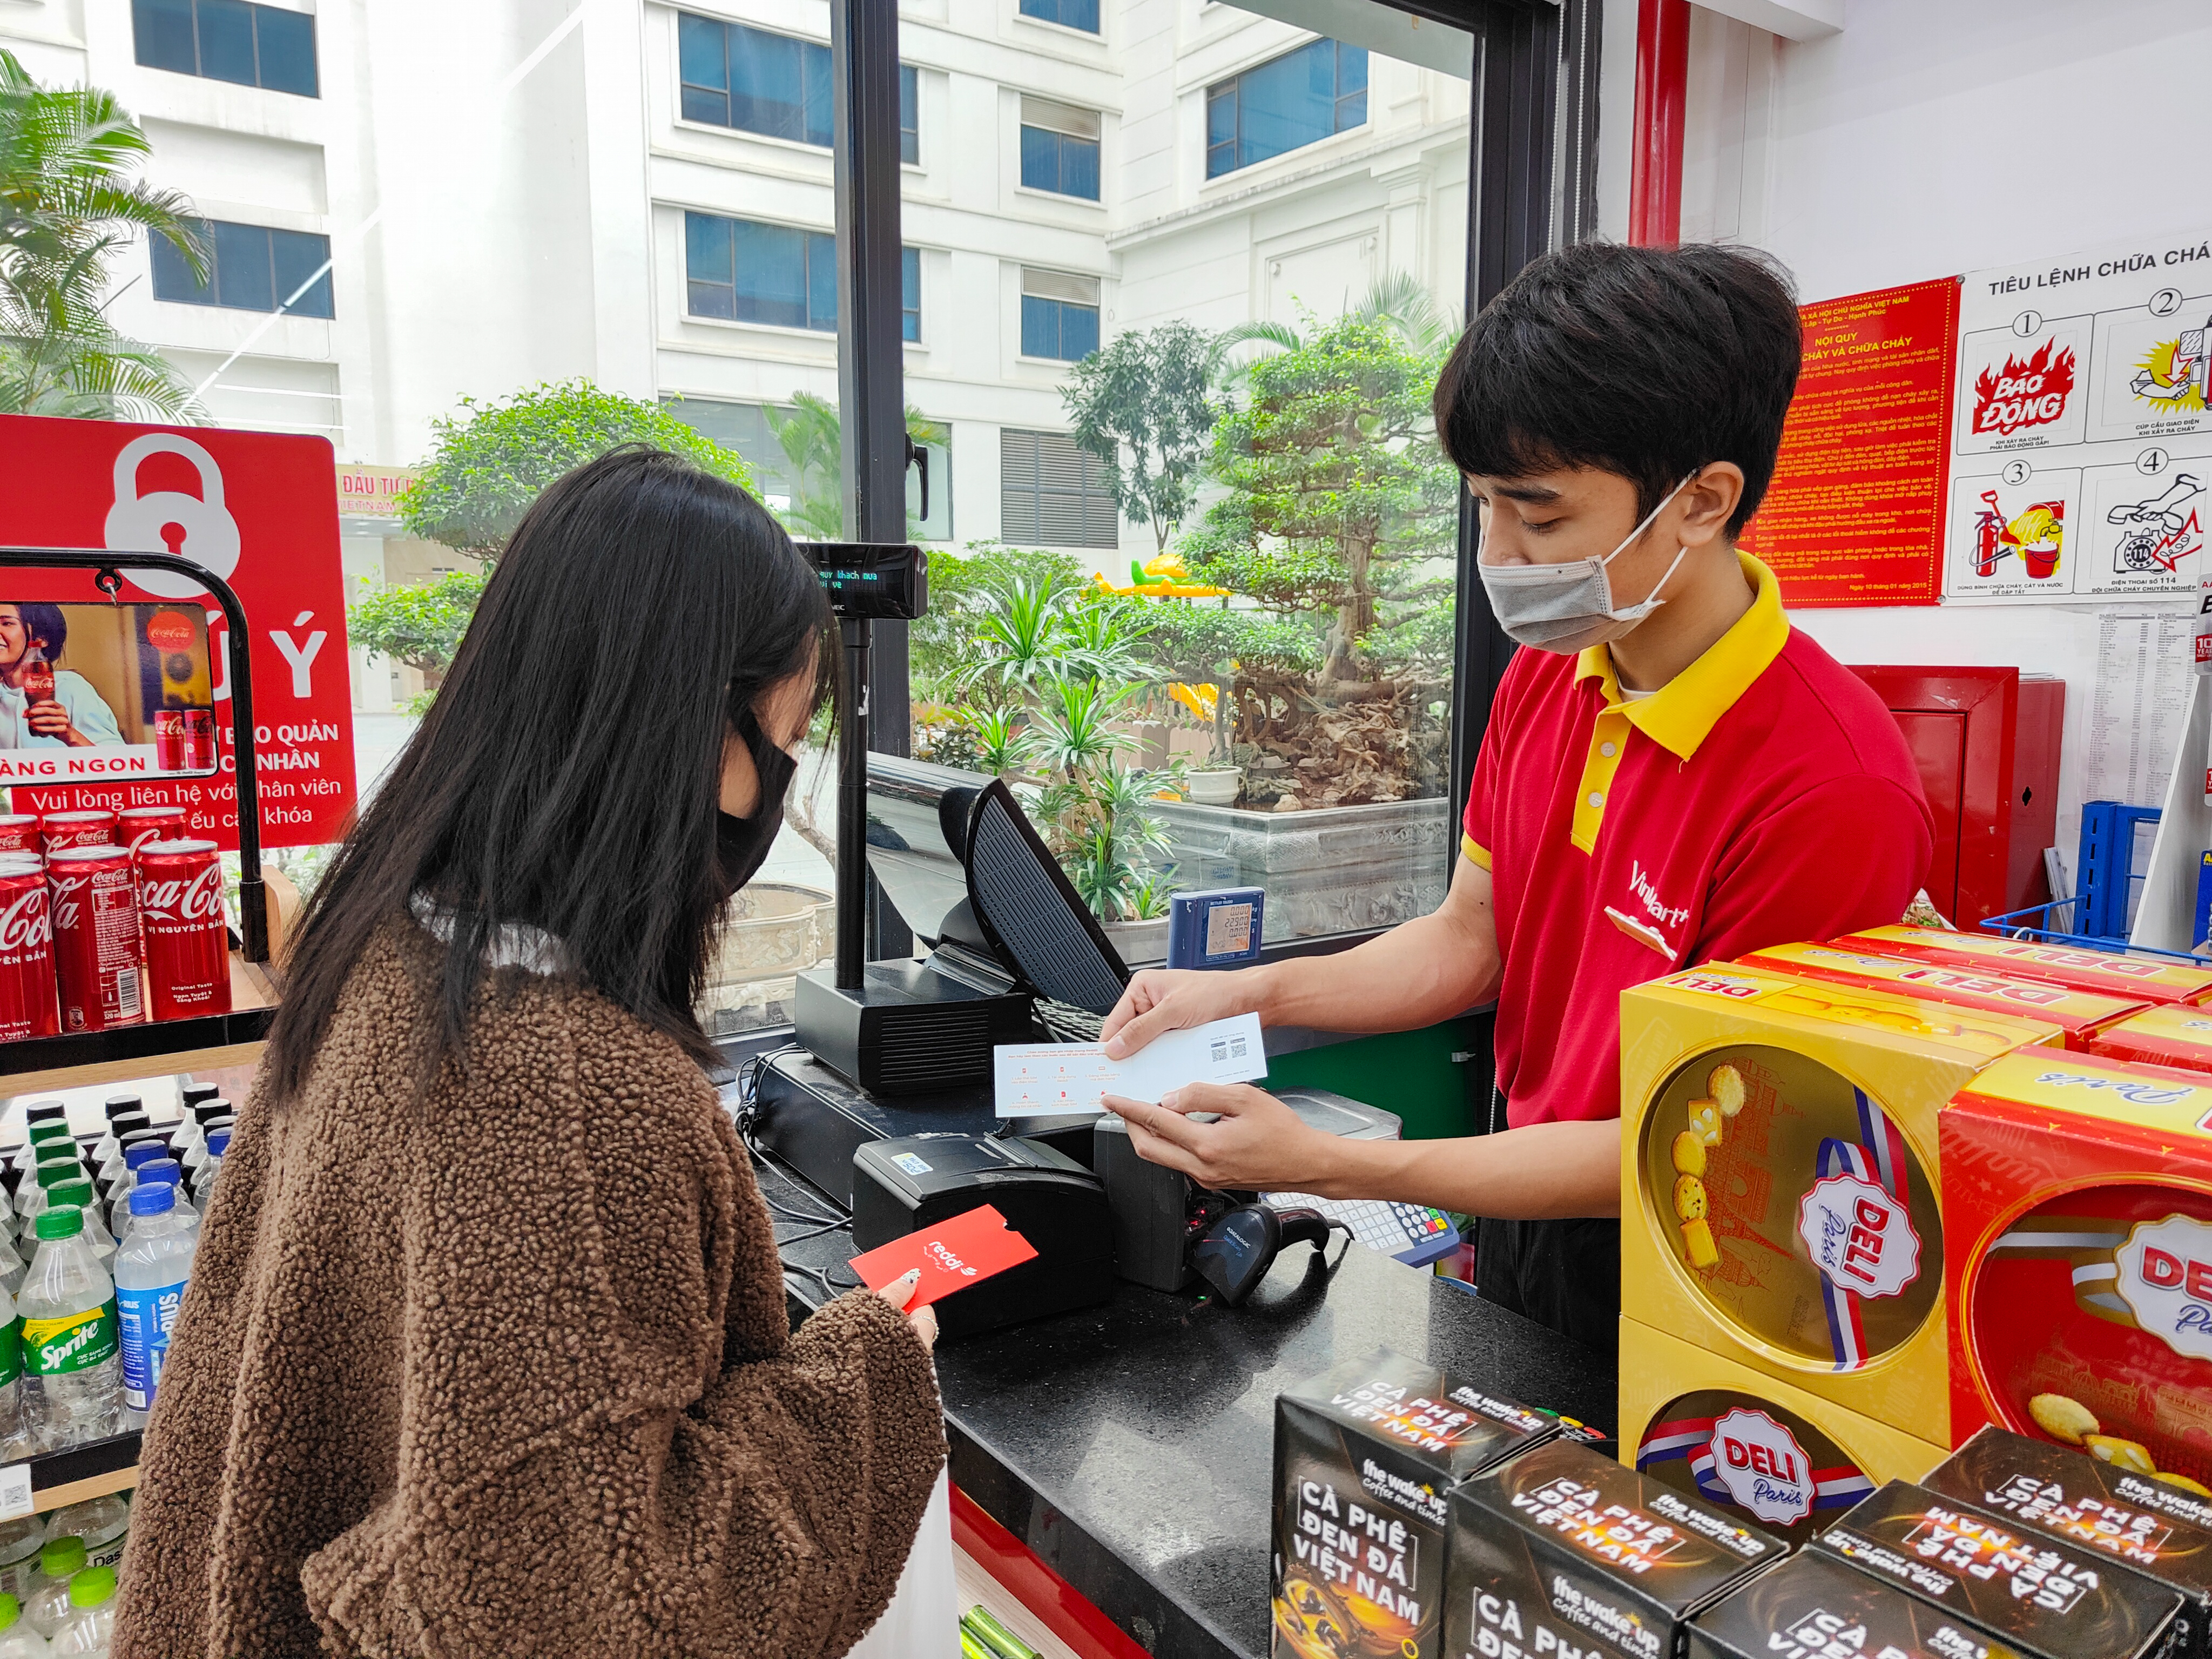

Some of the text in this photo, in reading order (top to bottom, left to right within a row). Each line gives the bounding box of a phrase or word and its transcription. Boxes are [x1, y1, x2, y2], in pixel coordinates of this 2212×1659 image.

[1988, 276, 2031, 295] TIÊU
[2037, 268, 2090, 287] LỆNH
[2098, 253, 2156, 276] CHỮA
[1892, 296, 1910, 304] NAM
[2157, 292, 2173, 313] 2
[2022, 314, 2031, 334] 1
[1831, 346, 1846, 358] VÀ
[1848, 341, 1879, 355] CHỮA
[1881, 335, 1913, 349] CHÁY
[1993, 372, 2046, 400] BÁO
[2011, 463, 2024, 483] 3
[2143, 451, 2160, 471] 4
[2133, 548, 2149, 559] 114
[838, 569, 860, 580] khach
[862, 572, 878, 581] mua
[277, 718, 339, 747] QUẢN
[68, 757, 145, 774] NGON
[257, 748, 320, 771] NHÂN
[30, 791, 68, 811] Vui
[76, 789, 125, 812] lòng
[131, 786, 168, 805] liên
[176, 785, 202, 806] hệ
[259, 780, 295, 798] hân
[301, 778, 341, 796] viên
[265, 806, 313, 825] khóa
[158, 923, 205, 934] NGUYÊN
[1998, 946, 2167, 978] DELI
[1664, 976, 1762, 999] DELI
[1898, 969, 2071, 1006] DELI
[1818, 1203, 1846, 1269] Paris
[1842, 1197, 1892, 1285] DELI
[928, 1241, 963, 1270] reddi
[41, 1321, 99, 1371] Sprite
[1354, 1389, 1411, 1417] ĐEN
[1409, 1398, 1468, 1428] PHÊ
[1383, 1419, 1447, 1452] NAM
[1722, 1434, 1799, 1486] DELI
[1363, 1459, 1387, 1483] the
[1387, 1474, 1426, 1501] wake
[1754, 1478, 1803, 1505] Paris
[2120, 1476, 2154, 1496] the
[1302, 1481, 1407, 1554] CÀ PHÊ
[1537, 1489, 1605, 1526] ĐEN
[1555, 1481, 1674, 1544] CÀ PHÊ
[1657, 1494, 1689, 1512] the
[1688, 1508, 1736, 1535] wake
[2005, 1487, 2083, 1522] ĐEN
[2016, 1477, 2159, 1535] CÀ PHÊ
[1924, 1506, 2012, 1547] NAM
[1302, 1509, 1407, 1587] ĐEN ĐÁ
[1575, 1530, 1653, 1574] NAM
[2067, 1526, 2158, 1564] NAM
[1293, 1533, 1420, 1626] VIỆT NAM
[1915, 1537, 2064, 1610] CÀ PHÊ
[1991, 1552, 2079, 1597] ĐEN
[1478, 1594, 1523, 1640] CÀ
[1553, 1575, 1582, 1606] the
[1584, 1596, 1631, 1635] wake
